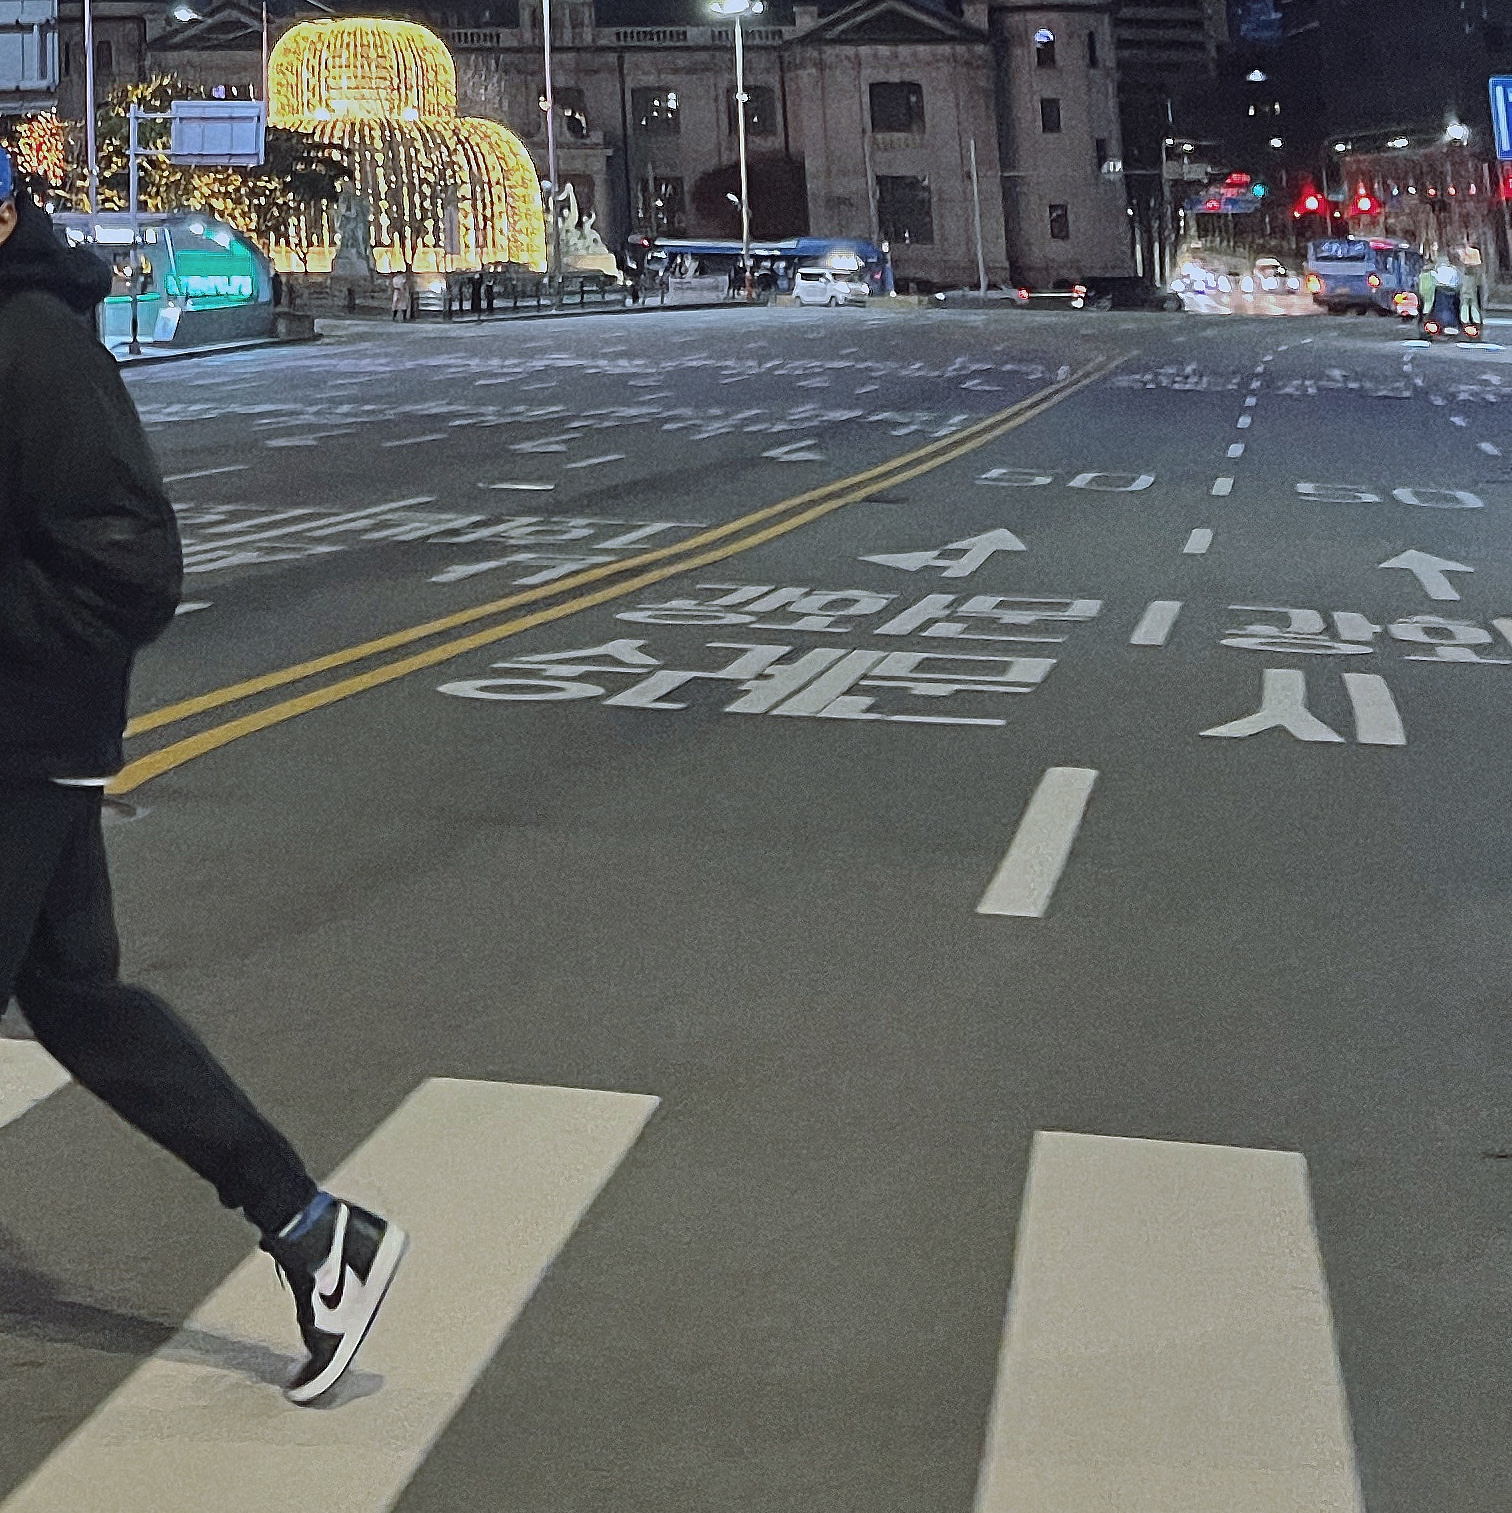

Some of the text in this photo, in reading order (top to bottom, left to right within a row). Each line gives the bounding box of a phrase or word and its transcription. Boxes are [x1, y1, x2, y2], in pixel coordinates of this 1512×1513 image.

[975, 469, 1157, 492] 50
[1295, 482, 1485, 508] 50
[615, 584, 1102, 643] 광화문
[436, 639, 1057, 725] 숭례문
